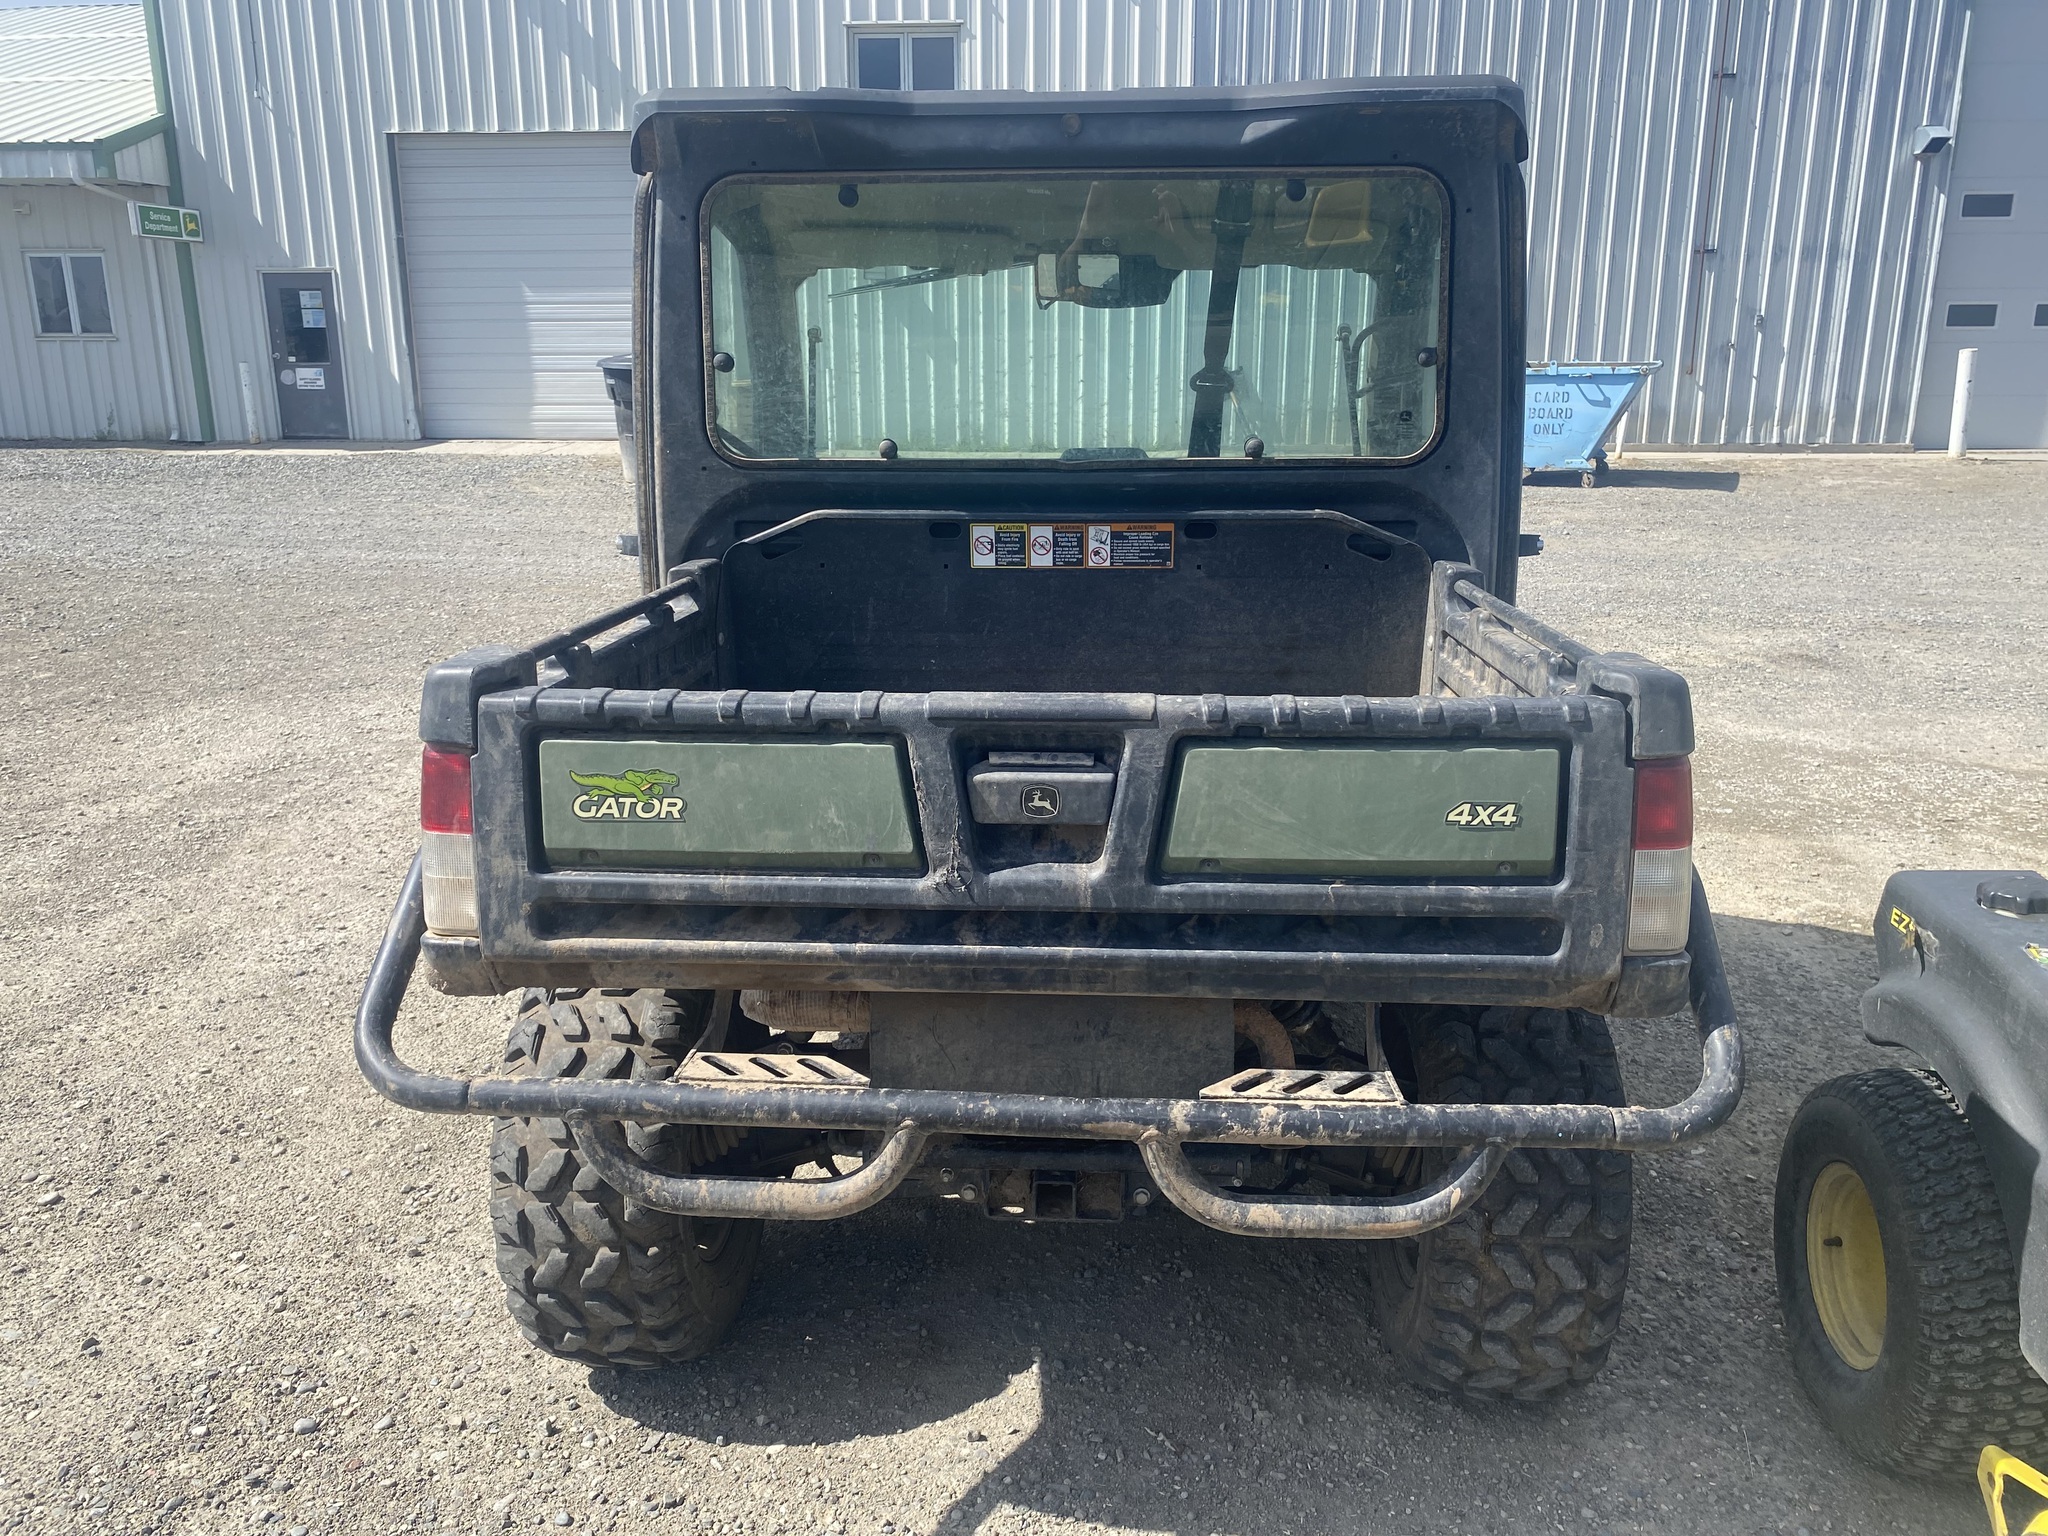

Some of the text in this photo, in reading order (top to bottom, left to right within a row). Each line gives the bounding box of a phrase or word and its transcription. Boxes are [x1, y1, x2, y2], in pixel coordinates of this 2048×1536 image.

[149, 211, 171, 221] Service
[144, 221, 178, 232] Department
[1534, 391, 1570, 403] CARD
[1528, 407, 1573, 419] BOARD
[1533, 423, 1565, 435] ONLY
[572, 794, 684, 819] GATOR
[1446, 802, 1518, 826] 4x4
